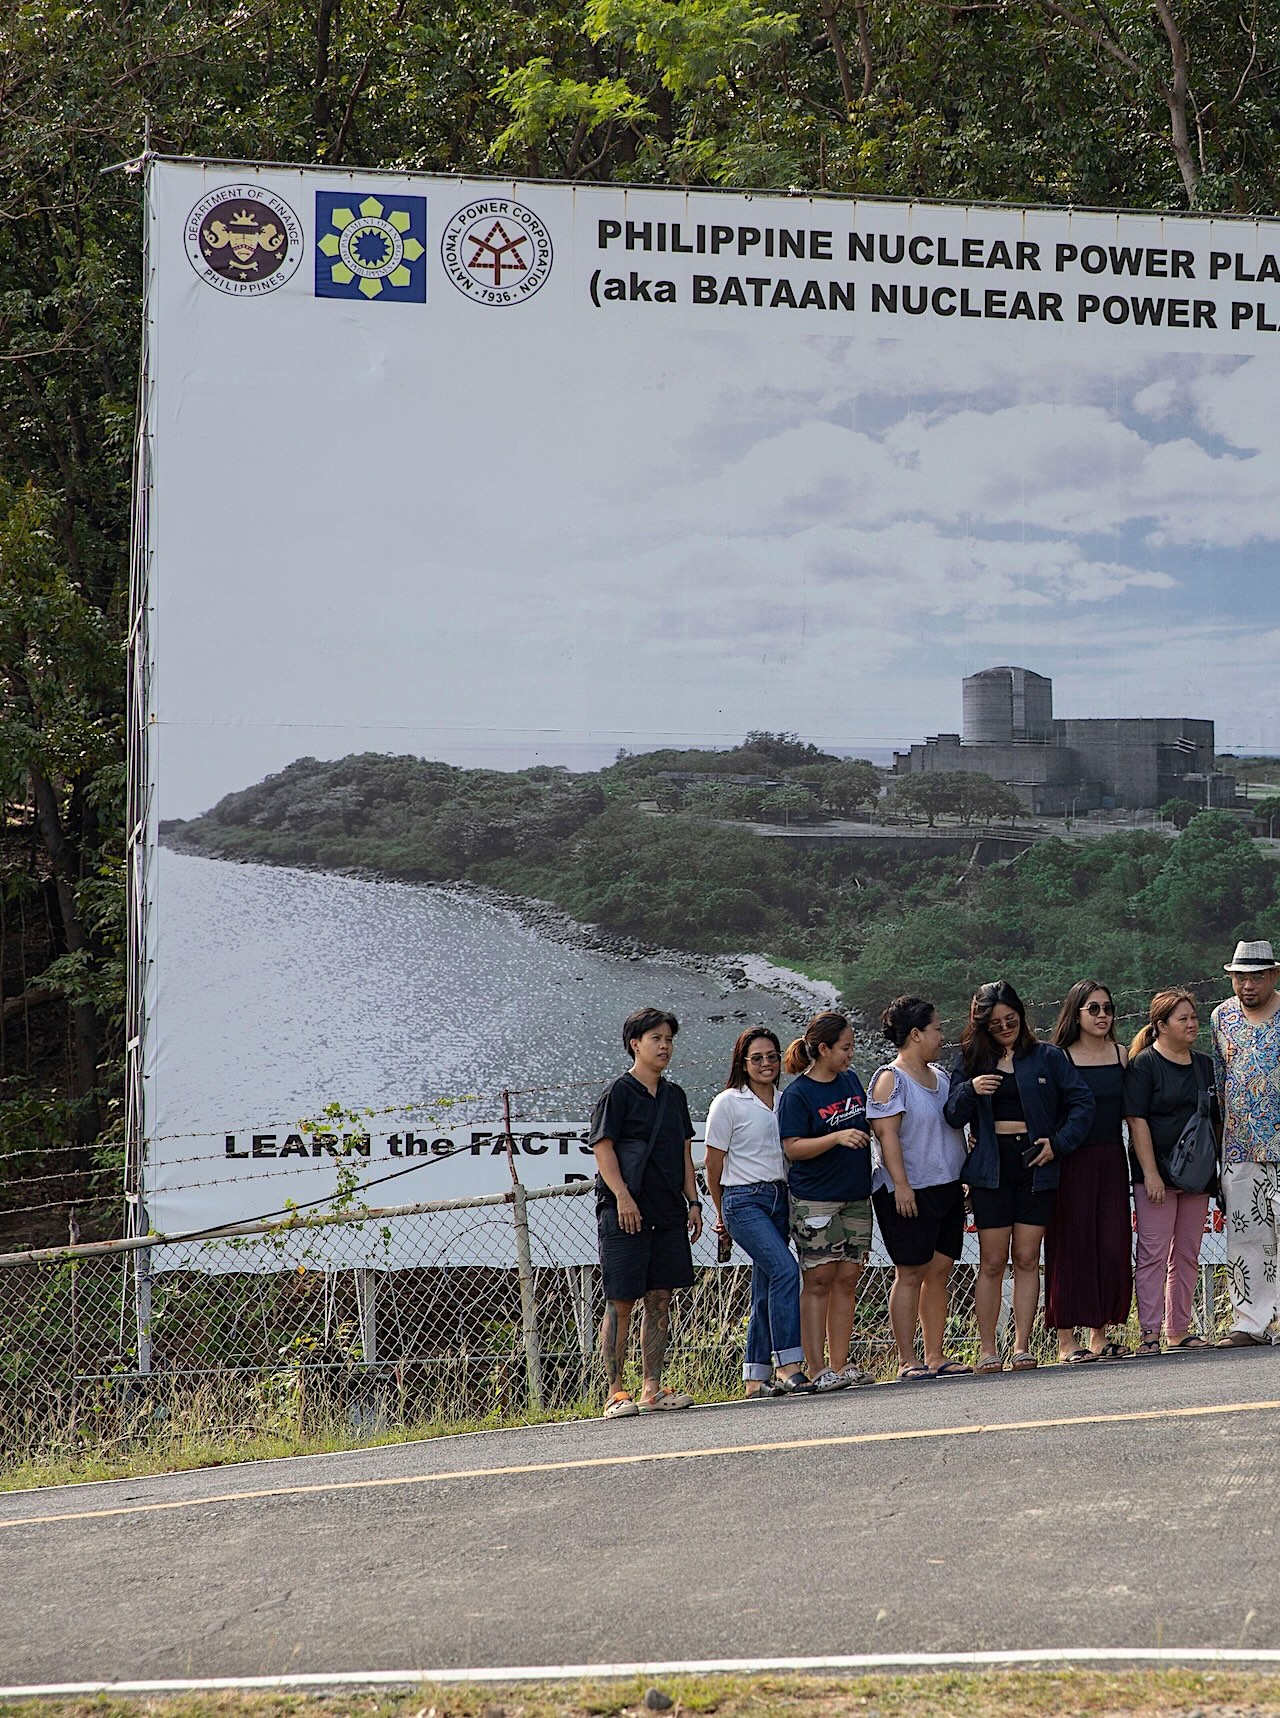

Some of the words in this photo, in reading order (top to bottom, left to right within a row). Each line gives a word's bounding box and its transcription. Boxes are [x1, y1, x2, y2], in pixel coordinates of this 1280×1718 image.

[188, 188, 243, 241] DEPARTMENT
[247, 189, 264, 200] OF
[268, 198, 300, 246] FINANCE
[458, 202, 509, 226] POWER
[341, 219, 374, 262] DEPARTMENT
[377, 221, 388, 229] OF
[388, 228, 402, 264] ENERGY
[445, 228, 474, 290] NATIONAL
[512, 207, 549, 294] CORPORATION
[598, 219, 833, 261] PHILIPPINE
[848, 232, 1042, 272] NUCLEAR
[1055, 243, 1197, 280] POWER
[203, 268, 286, 293] PHILIPPINES
[481, 289, 511, 303] 1936
[589, 269, 677, 308] (aka
[692, 273, 855, 312] BATAAN
[871, 283, 1065, 323] NUCLEAR
[1077, 293, 1218, 330] POWER
[817, 1095, 864, 1120] NEXT
[225, 1132, 372, 1160] LEARN
[386, 1132, 456, 1158] the
